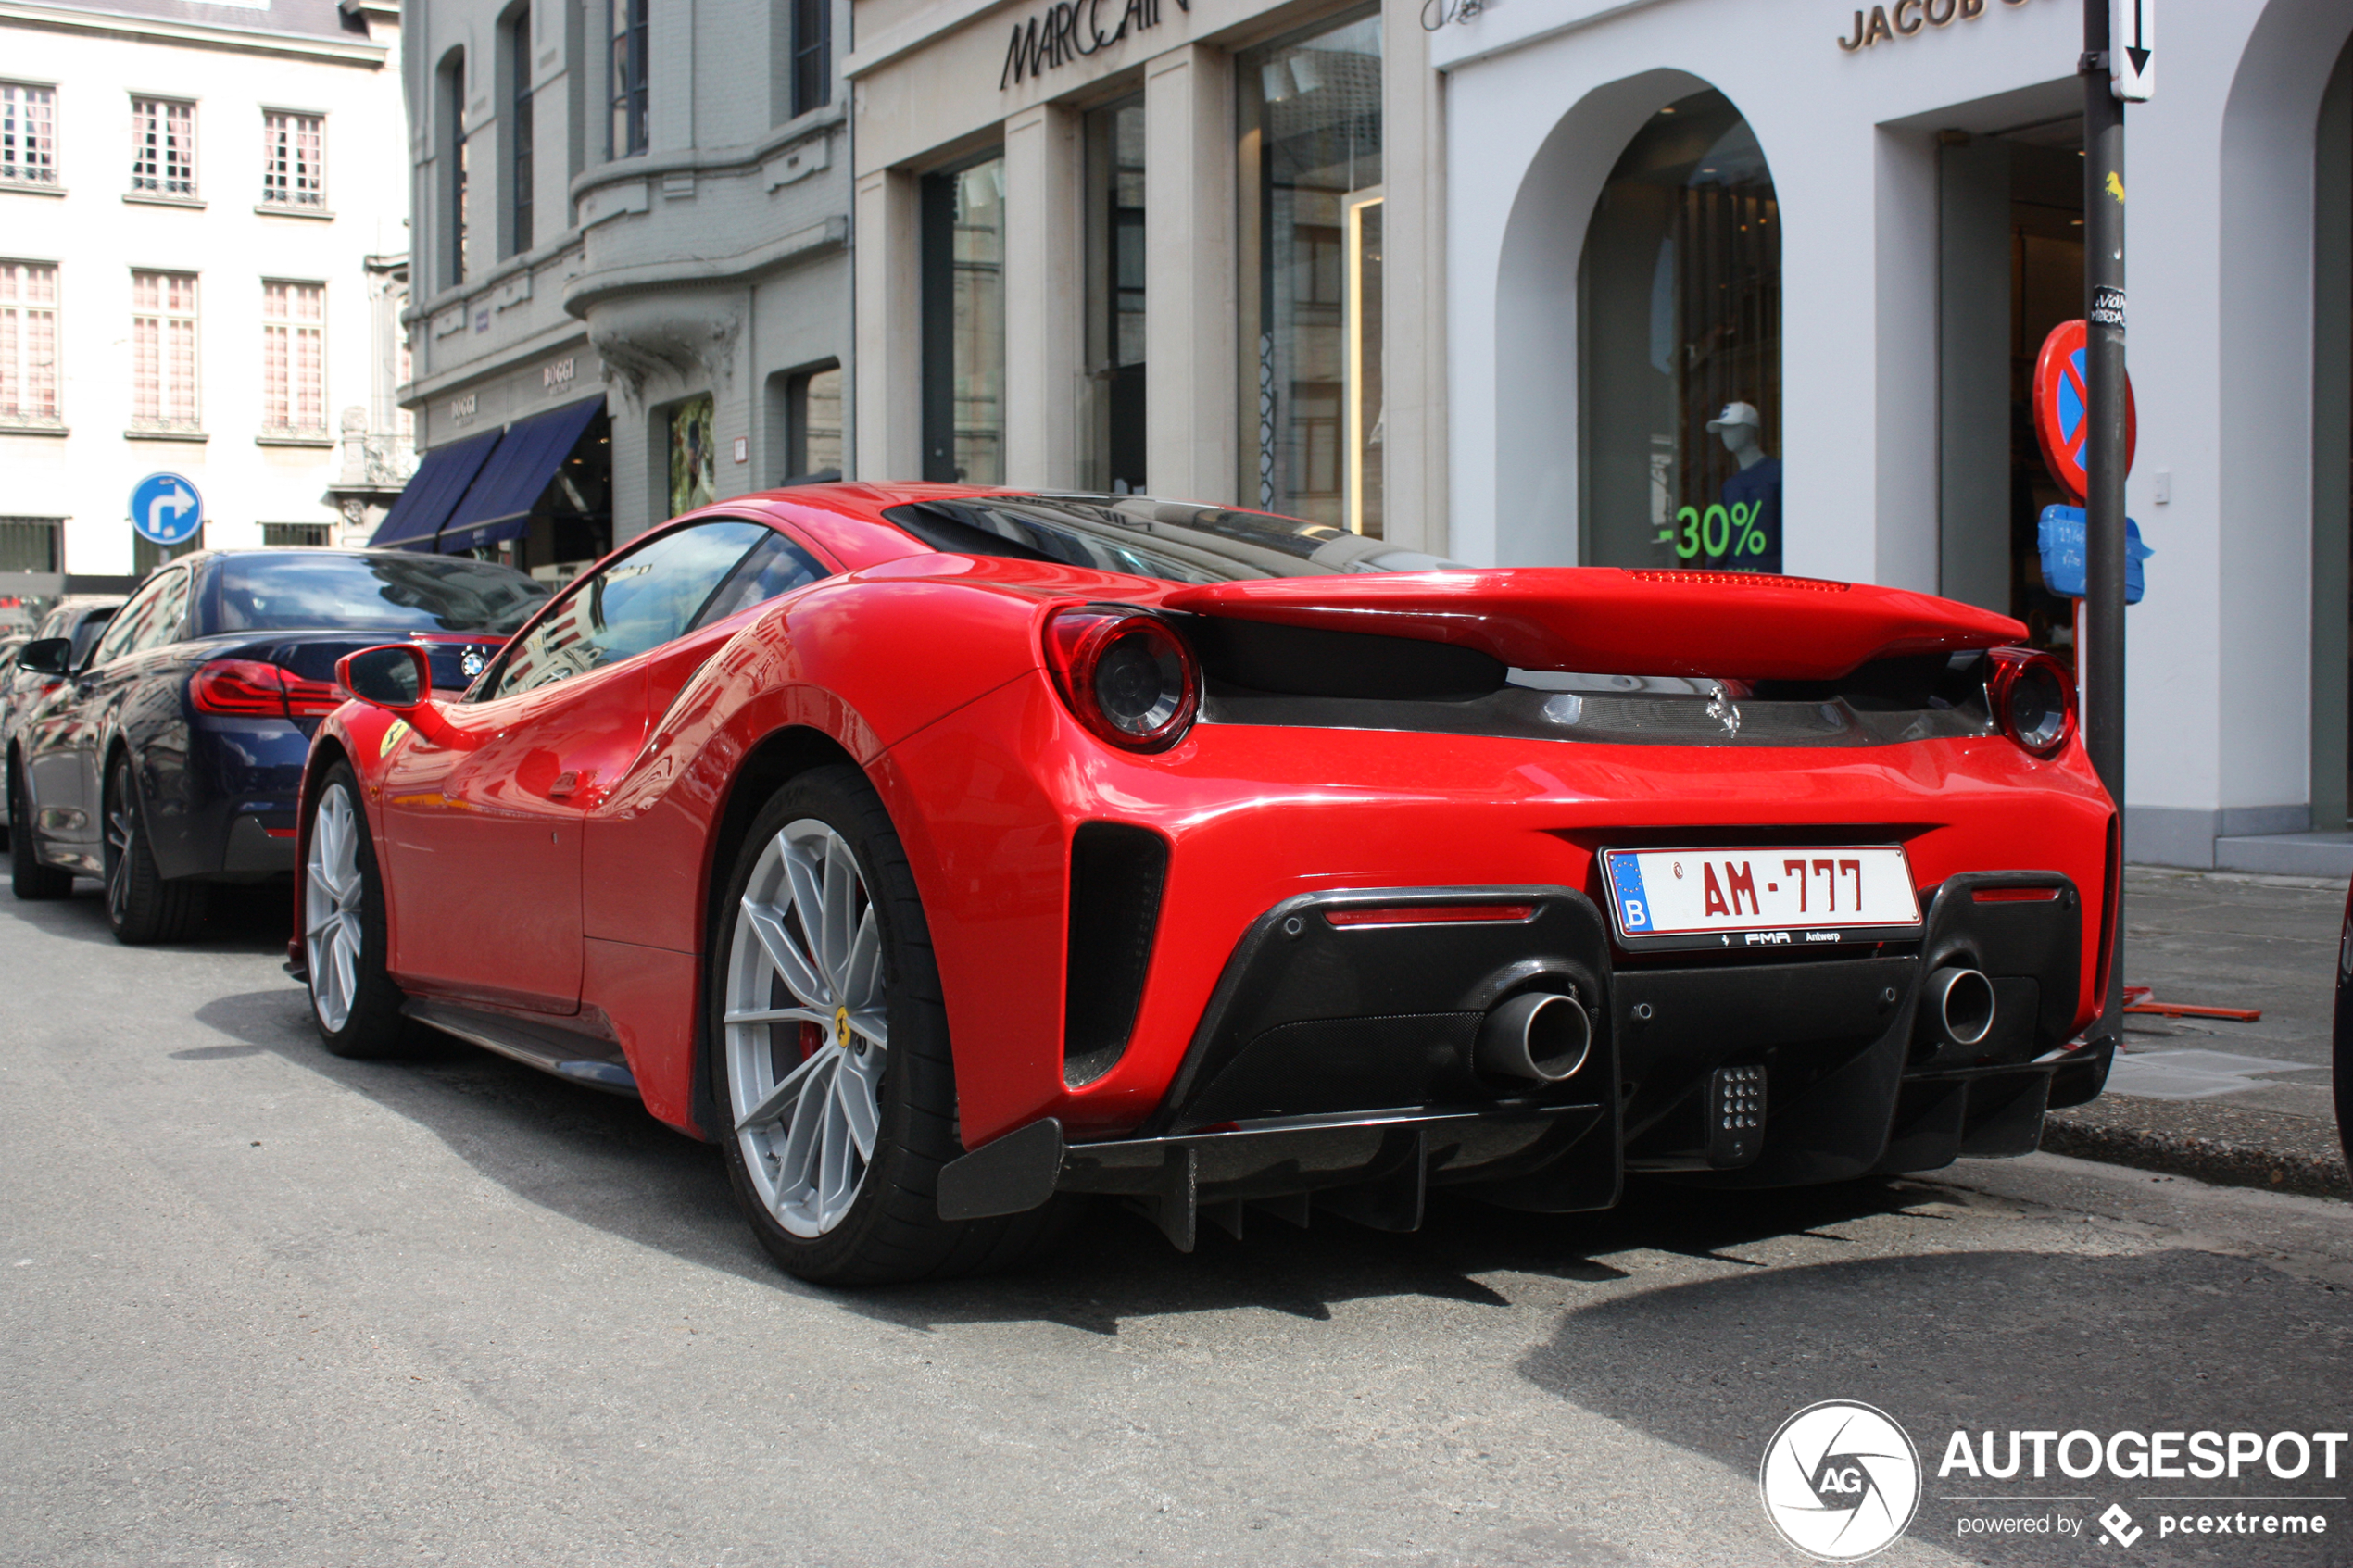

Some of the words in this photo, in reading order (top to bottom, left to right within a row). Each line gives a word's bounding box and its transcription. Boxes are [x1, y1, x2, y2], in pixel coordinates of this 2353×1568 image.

[1836, 0, 1986, 52] JACOB
[544, 358, 574, 387] BOGGI
[451, 394, 477, 418] BOGGI
[1659, 500, 1766, 558] -30%
[1625, 899, 1647, 926] B
[1745, 932, 1791, 946] FMA
[1806, 931, 1840, 943] Antwerp
